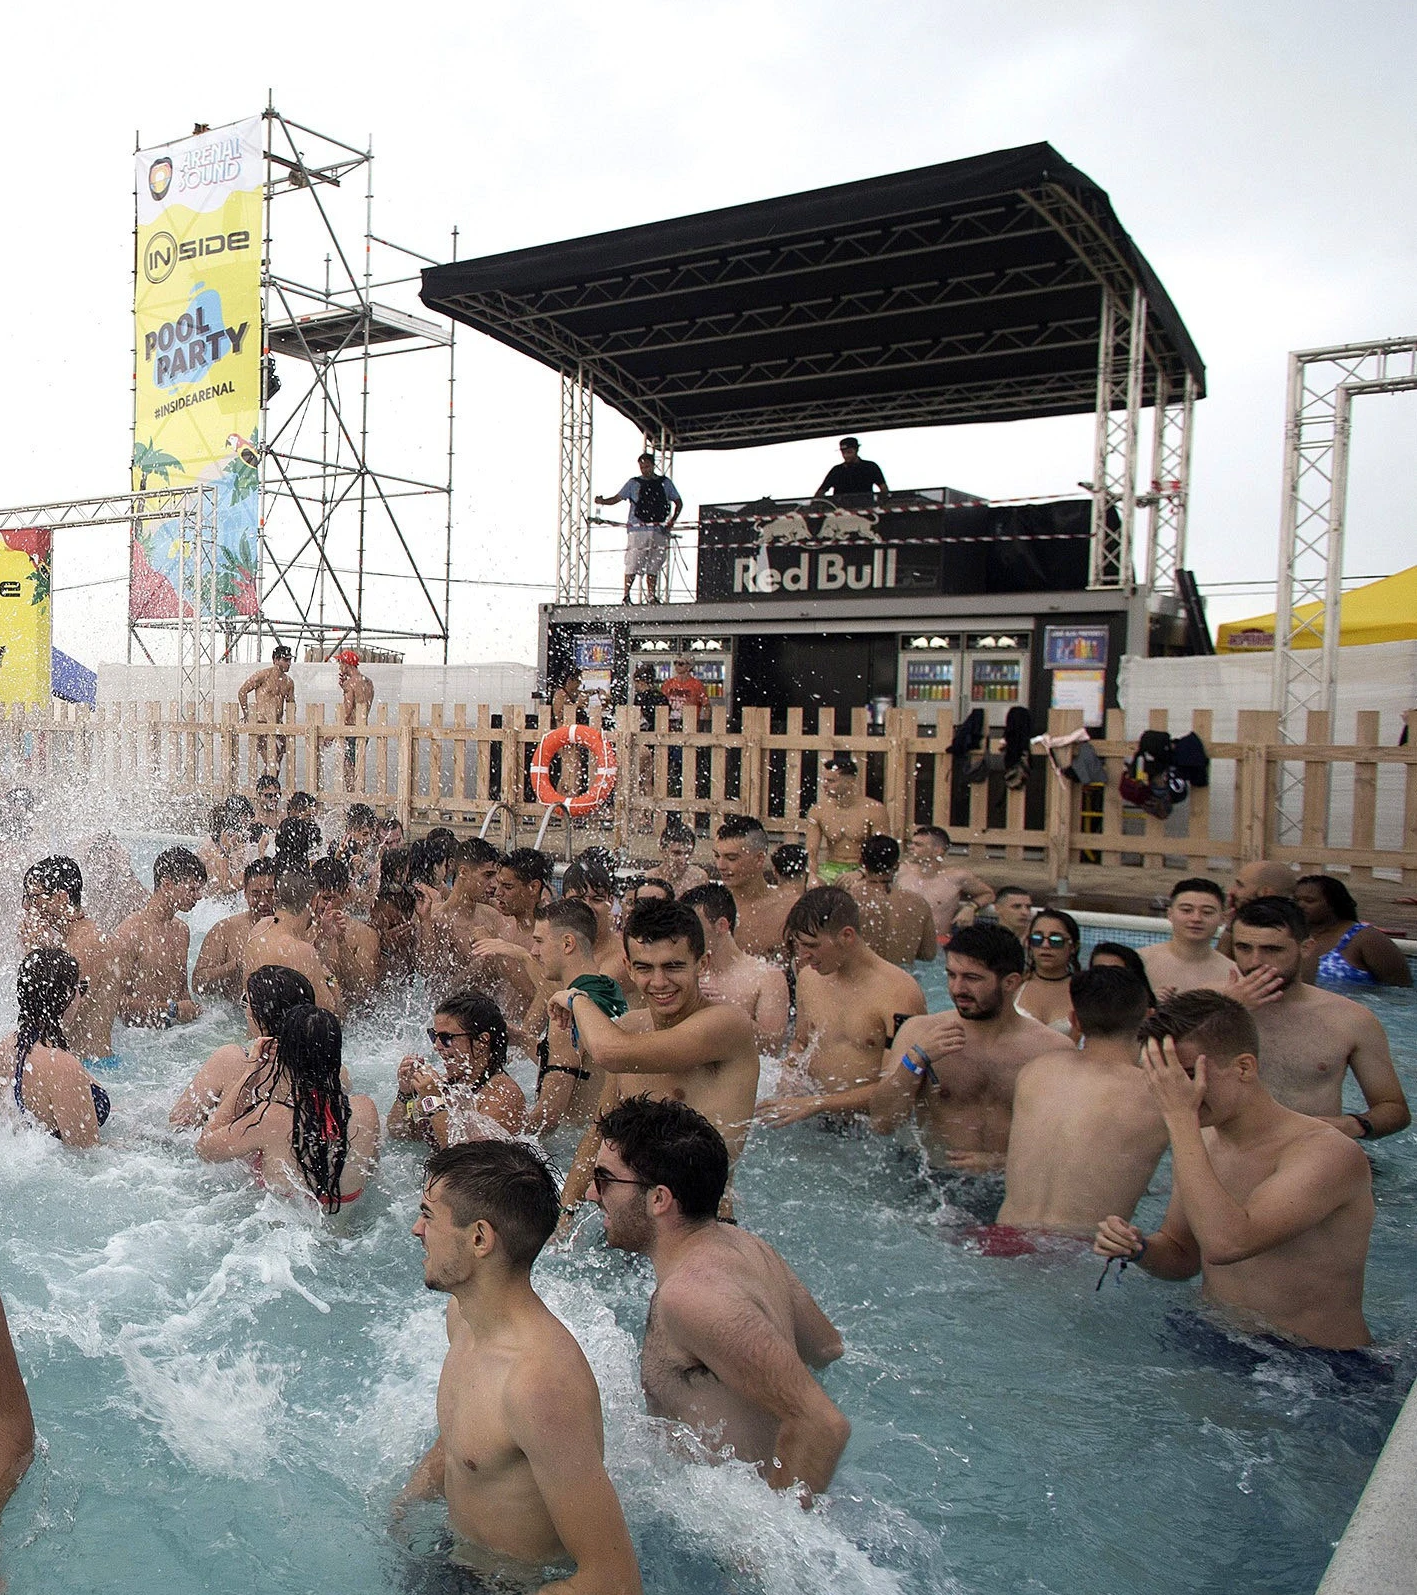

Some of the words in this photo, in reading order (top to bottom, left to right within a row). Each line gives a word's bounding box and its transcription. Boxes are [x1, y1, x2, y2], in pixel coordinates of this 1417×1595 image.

[183, 138, 242, 171] ARENAL
[179, 160, 241, 193] SOUND
[145, 306, 210, 361] POOL
[157, 322, 249, 385] PARTY
[154, 381, 235, 419] #INSIDEARENAL
[733, 553, 809, 593] Red
[817, 548, 897, 590] Bull
